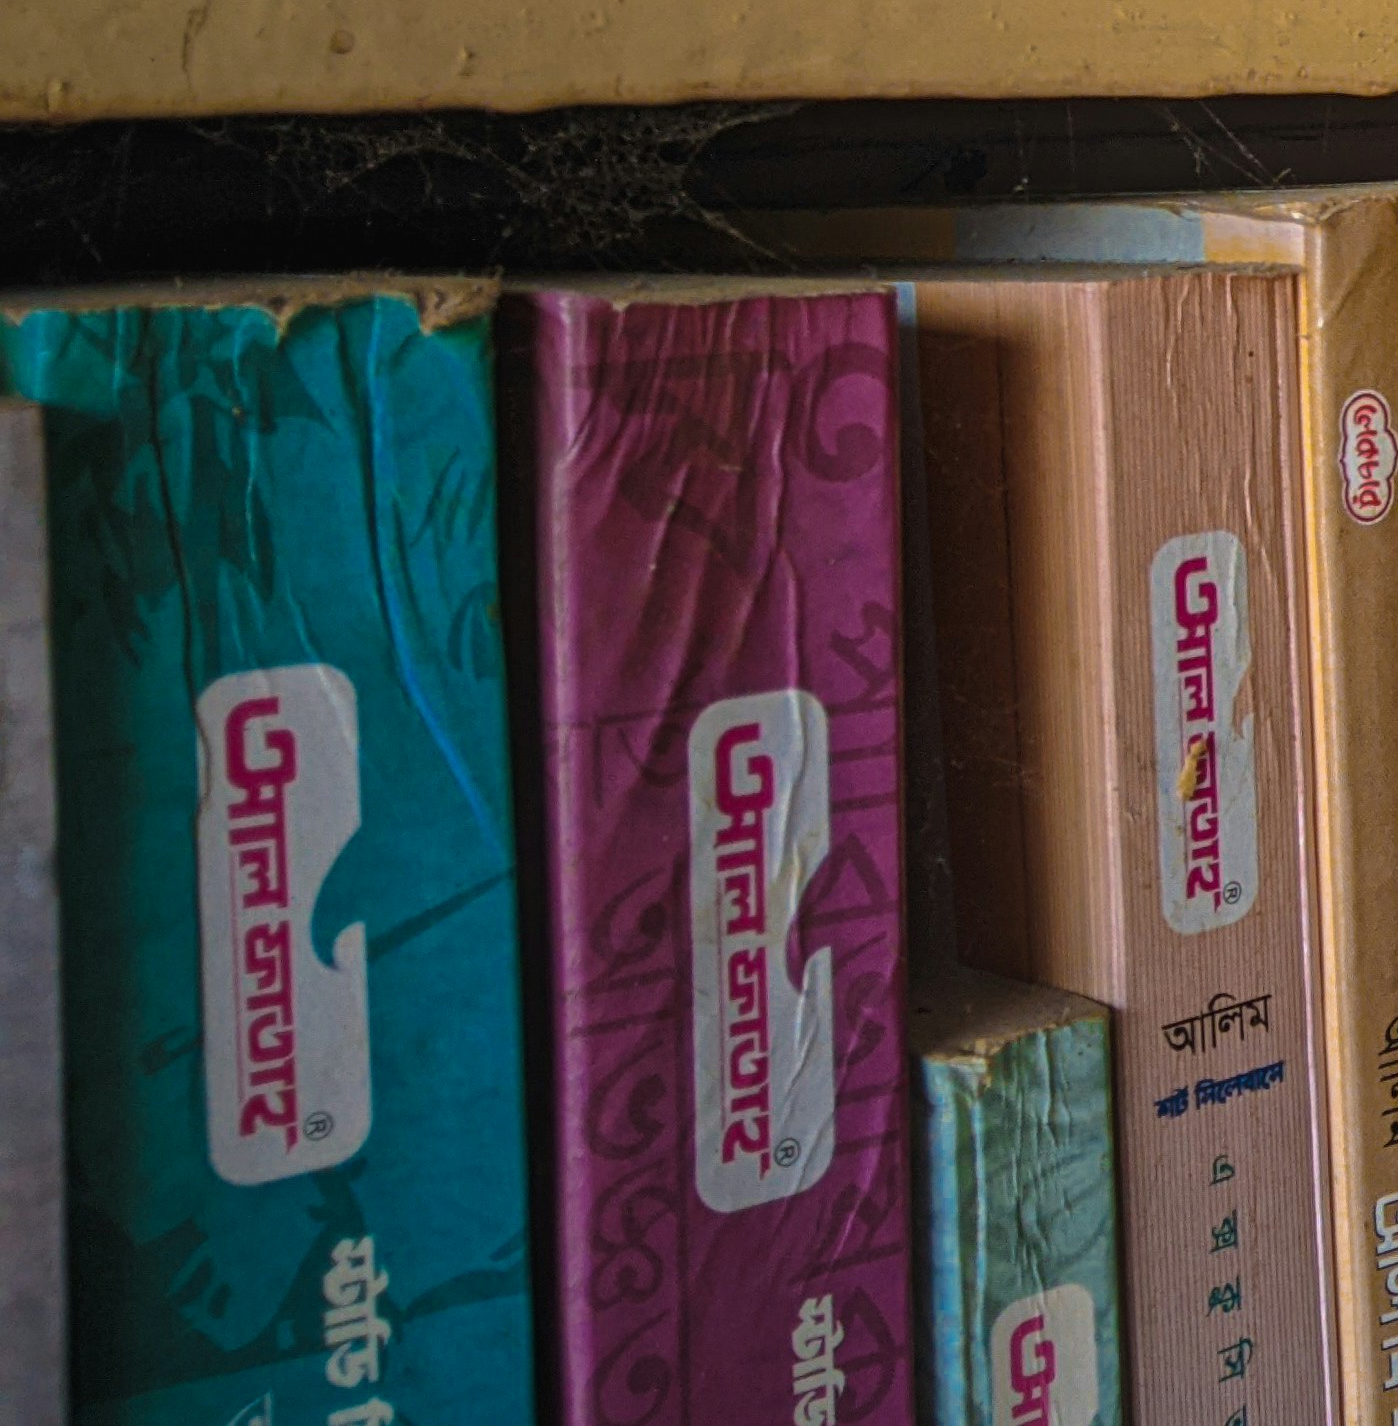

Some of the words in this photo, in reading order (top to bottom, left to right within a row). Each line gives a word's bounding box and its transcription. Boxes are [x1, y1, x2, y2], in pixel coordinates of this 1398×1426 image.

[1173, 556, 1224, 725] আল
[224, 696, 298, 909] আল
[712, 721, 776, 938] আল
[1161, 993, 1273, 1056] আলিম
